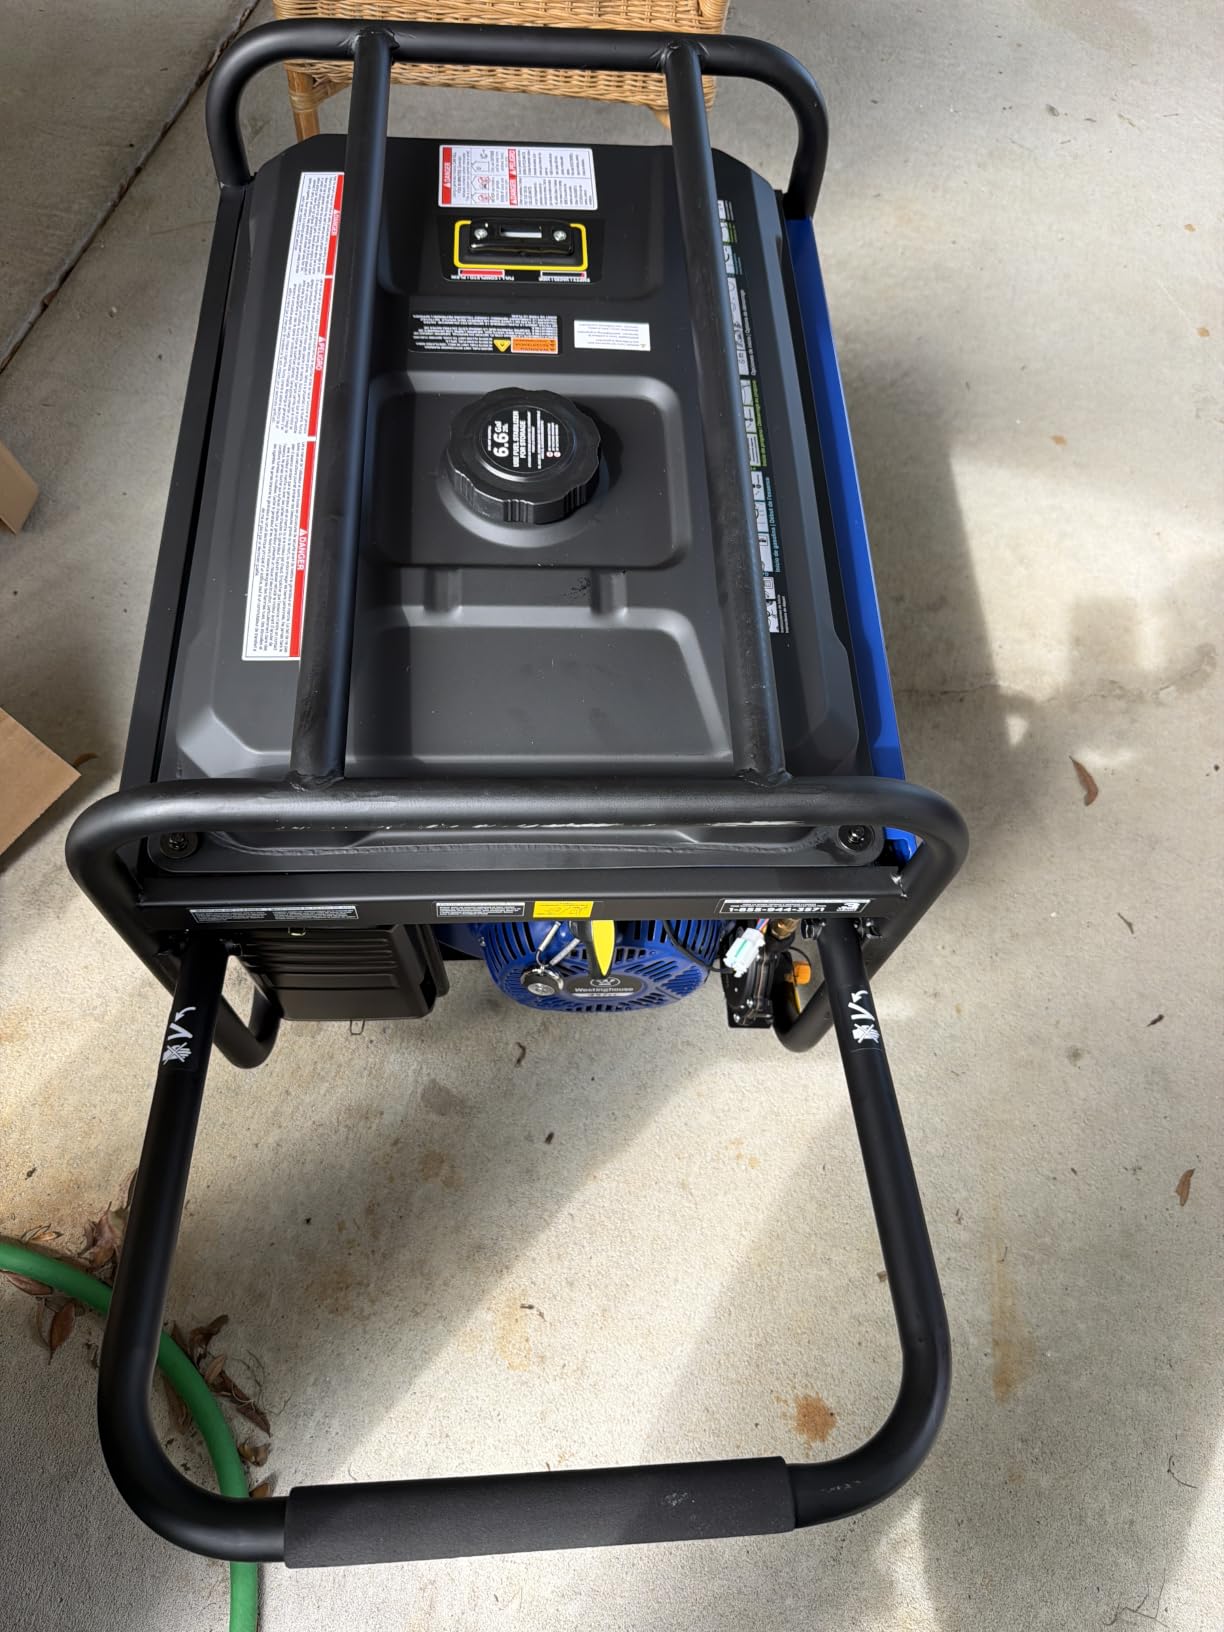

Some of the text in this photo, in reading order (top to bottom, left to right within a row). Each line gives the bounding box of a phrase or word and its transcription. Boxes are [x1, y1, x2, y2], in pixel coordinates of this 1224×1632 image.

[315, 342, 324, 370] PELIGRO
[493, 433, 509, 457] 6.6
[296, 536, 305, 570] DANGER
